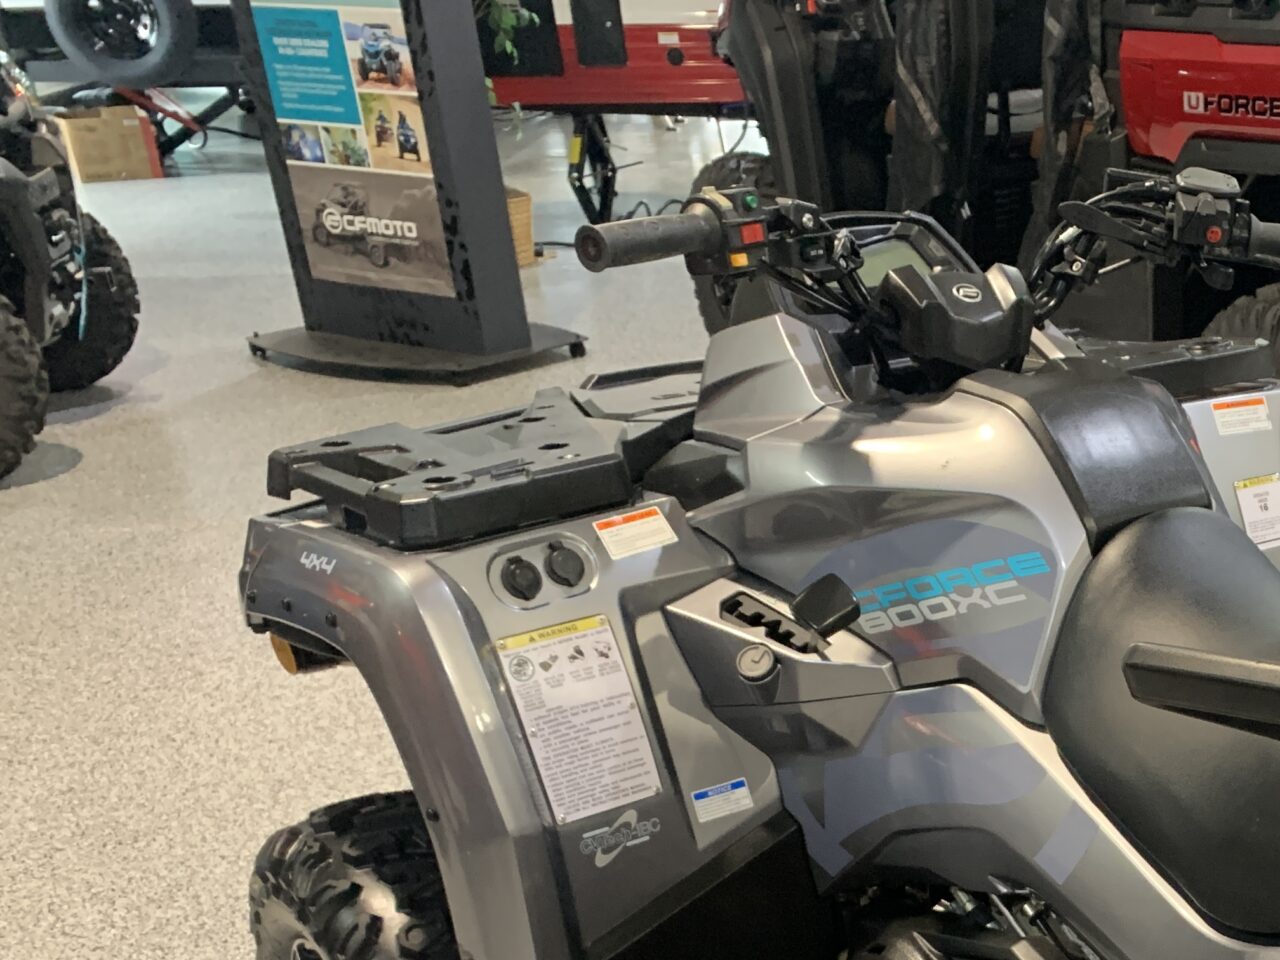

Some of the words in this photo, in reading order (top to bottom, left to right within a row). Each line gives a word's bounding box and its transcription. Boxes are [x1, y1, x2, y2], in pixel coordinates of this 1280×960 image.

[342, 214, 418, 238] CFMOTO
[857, 580, 1028, 635] 800XC
[537, 623, 579, 640] WARNING
